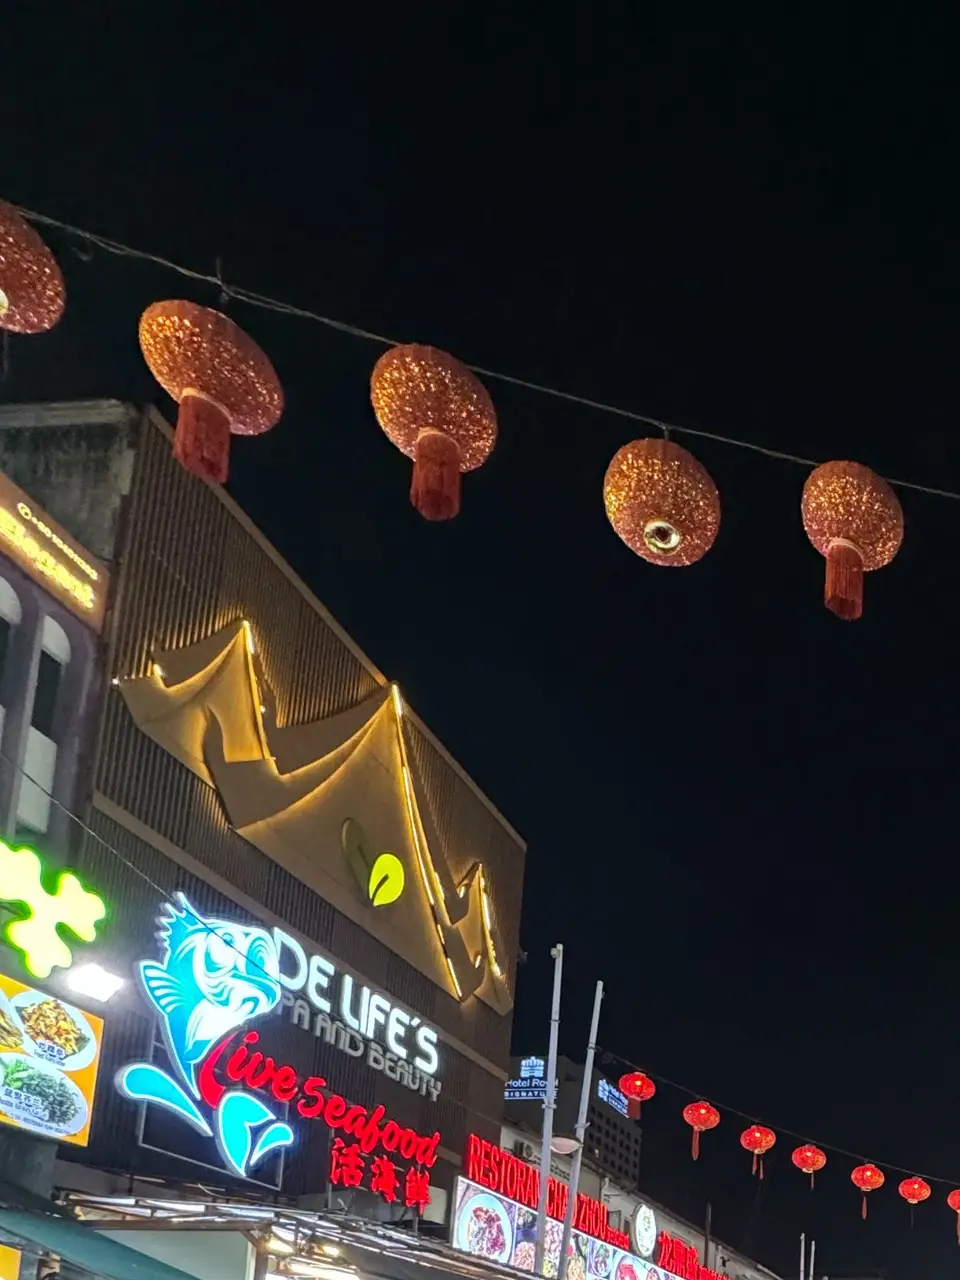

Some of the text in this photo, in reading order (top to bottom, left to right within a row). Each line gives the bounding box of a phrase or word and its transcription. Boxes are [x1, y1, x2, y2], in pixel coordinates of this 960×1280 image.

[273, 926, 438, 1075] DE LIFE'S
[314, 1012, 365, 1058] AND
[366, 1042, 442, 1102] BEAUTY
[505, 1079, 530, 1088] Hotel
[296, 1075, 441, 1168] Seafood
